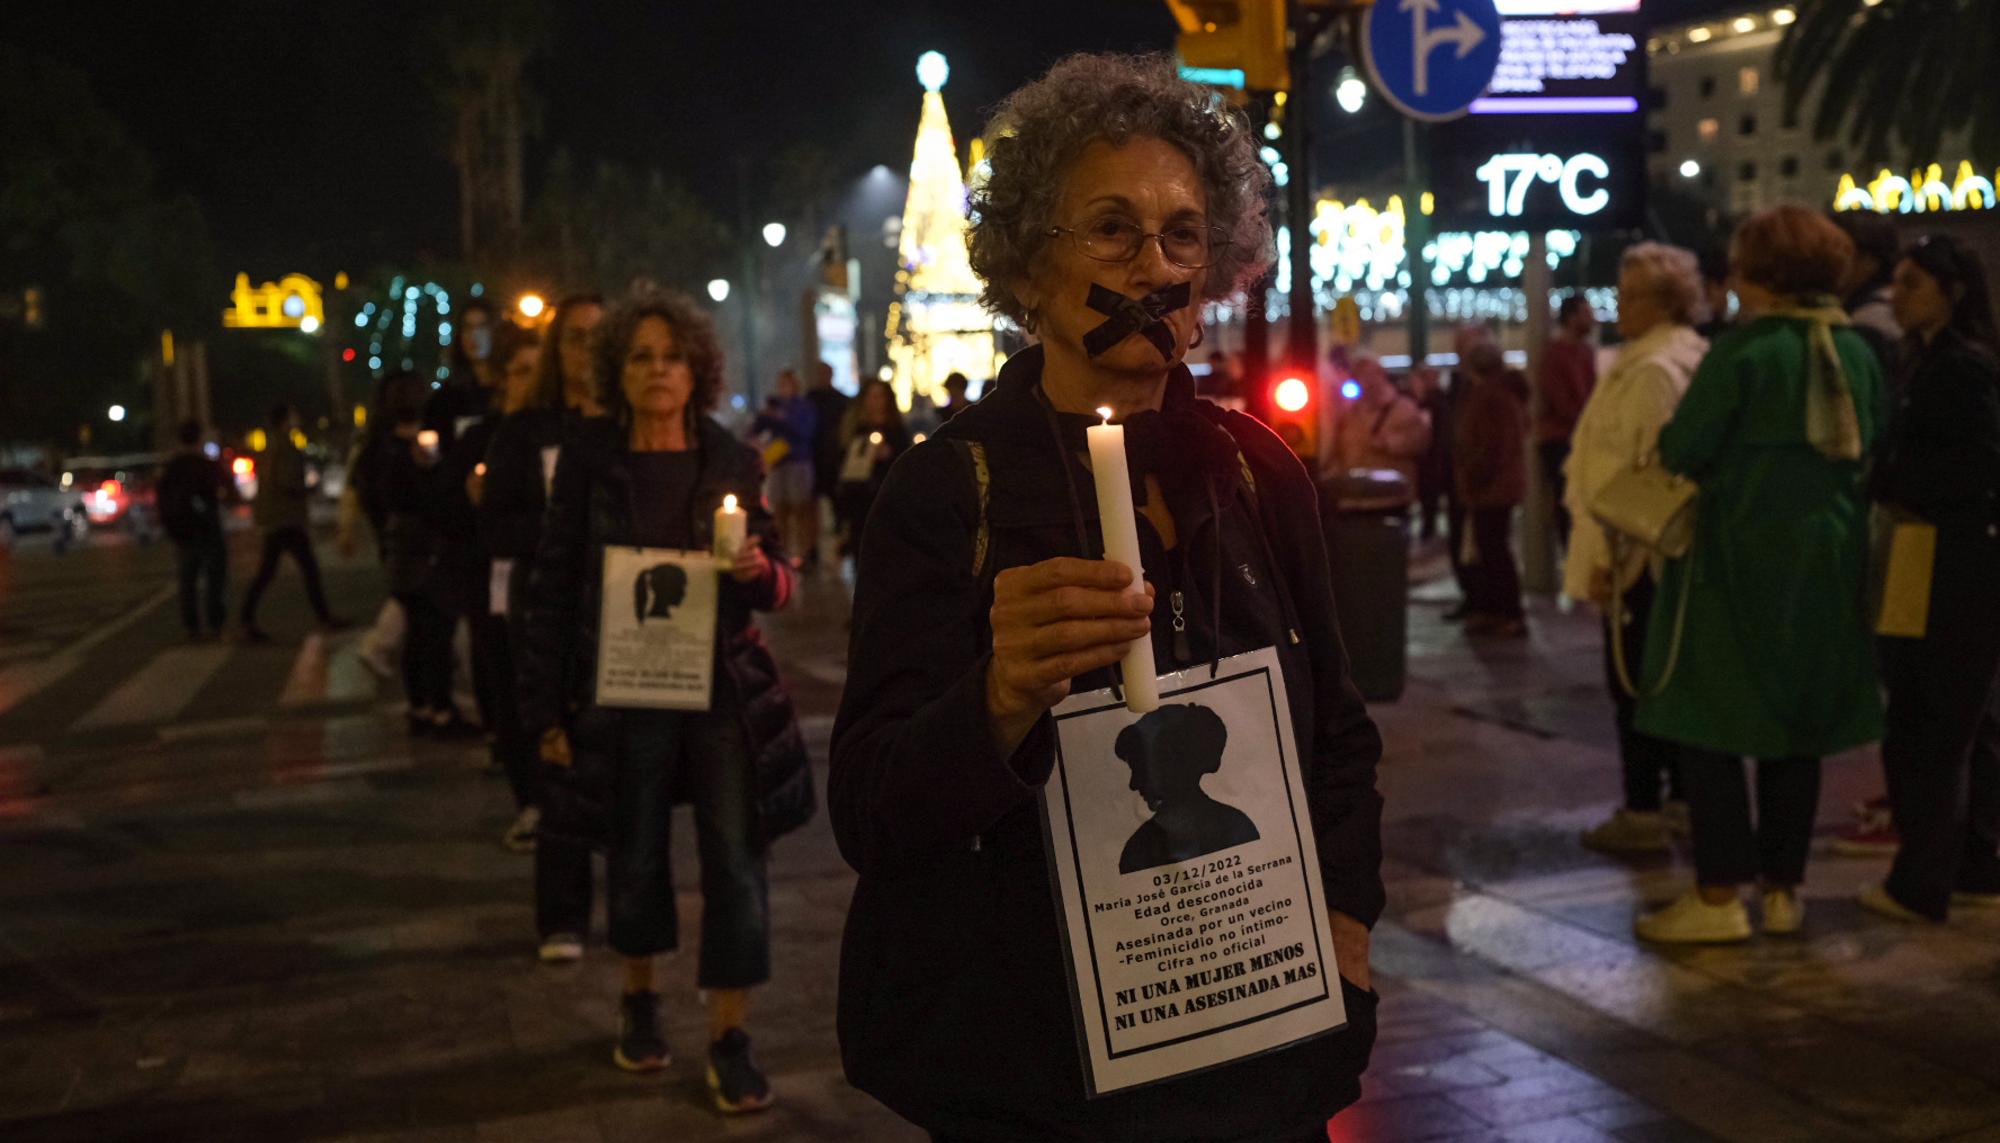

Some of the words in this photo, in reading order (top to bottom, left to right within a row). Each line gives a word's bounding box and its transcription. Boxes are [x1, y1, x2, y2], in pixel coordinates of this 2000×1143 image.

[1476, 152, 1610, 217] 17°C
[1095, 898, 1131, 913] María
[1137, 889, 1165, 904] José
[1170, 880, 1211, 895] García
[1216, 875, 1229, 884] de
[1233, 870, 1243, 879] la
[1248, 856, 1292, 874] Serrana
[1153, 855, 1241, 886] 03/12/2022
[1116, 928, 1193, 951] Asesinada
[1199, 921, 1222, 935] por
[1229, 914, 1244, 924] un
[1249, 898, 1291, 917] vecino
[1135, 903, 1170, 919] Edad
[1177, 879, 1263, 909] desconocida
[1160, 914, 1194, 926] Orce,
[1200, 897, 1249, 917] Granada
[1119, 937, 1213, 965] -Feminicidio
[1220, 931, 1236, 941] no
[1241, 915, 1289, 935] íntimo-
[1158, 958, 1194, 972] Cifra
[1200, 951, 1217, 962] no
[1224, 935, 1265, 956] oficial
[1115, 1013, 1136, 1030] NI
[1141, 1003, 1180, 1024] UNA
[1185, 978, 1280, 1014] ASESINADA
[1283, 963, 1317, 985] MAS
[1116, 989, 1137, 1006] NI
[1141, 979, 1180, 1000] UNA
[1185, 962, 1246, 990] MUJER
[1249, 943, 1304, 972] MENOS
